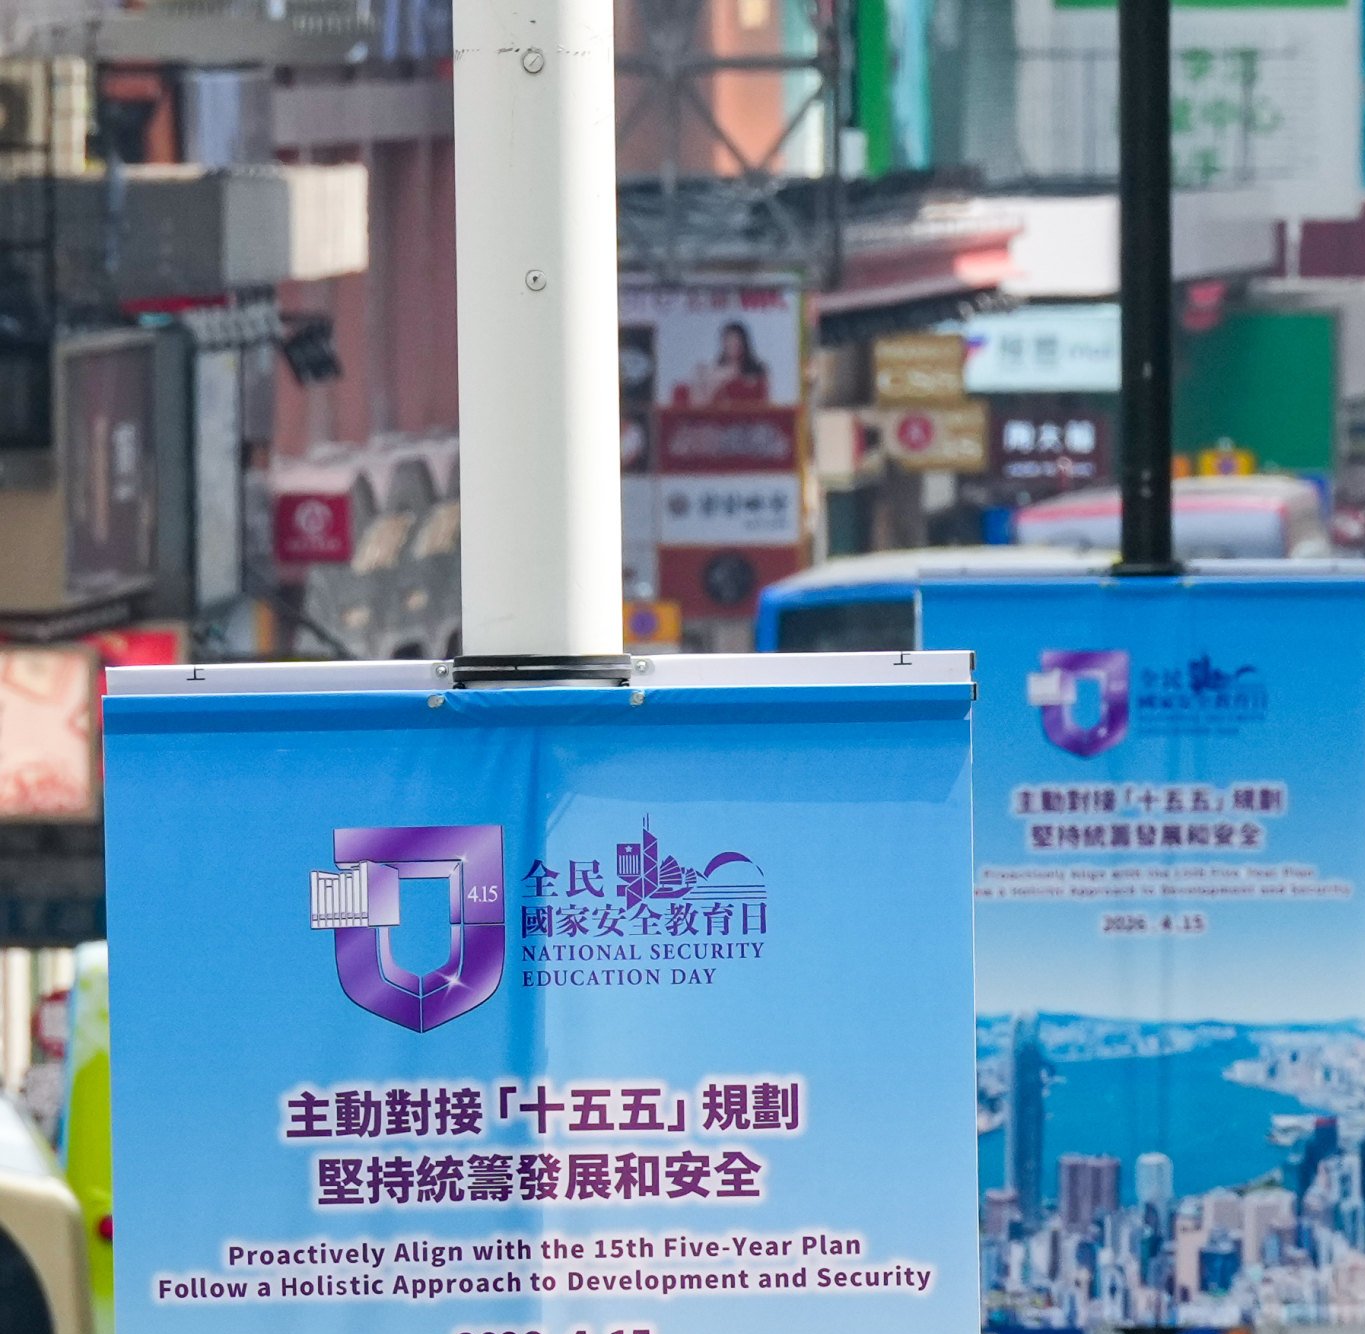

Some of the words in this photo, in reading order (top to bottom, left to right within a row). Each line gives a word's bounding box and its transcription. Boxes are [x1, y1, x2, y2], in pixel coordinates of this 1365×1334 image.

[467, 885, 498, 903] 4.15
[520, 859, 603, 897] 全民
[521, 902, 767, 938] 國家安全教育日
[522, 943, 641, 961] NATIONAL
[650, 942, 765, 960] SECURITY
[522, 968, 660, 987] EDUCATION
[671, 967, 717, 985] DAY
[286, 1083, 799, 1138] 主動對接「十五五」規劃
[318, 1150, 761, 1205] 堅持統籌發展和安全
[229, 1242, 385, 1268] Proactively
[394, 1241, 463, 1267] Align
[473, 1239, 532, 1261] with
[541, 1238, 584, 1260] the
[594, 1237, 654, 1259] 15th
[664, 1236, 792, 1257] Five-Year
[802, 1235, 861, 1256] Plan
[159, 1278, 248, 1299] Follow
[257, 1282, 271, 1298] a
[281, 1274, 384, 1297] Holistic
[393, 1272, 522, 1299] Approach
[530, 1273, 556, 1293] to
[568, 1269, 749, 1295] Development
[758, 1267, 807, 1289] and
[817, 1265, 931, 1292] Security
